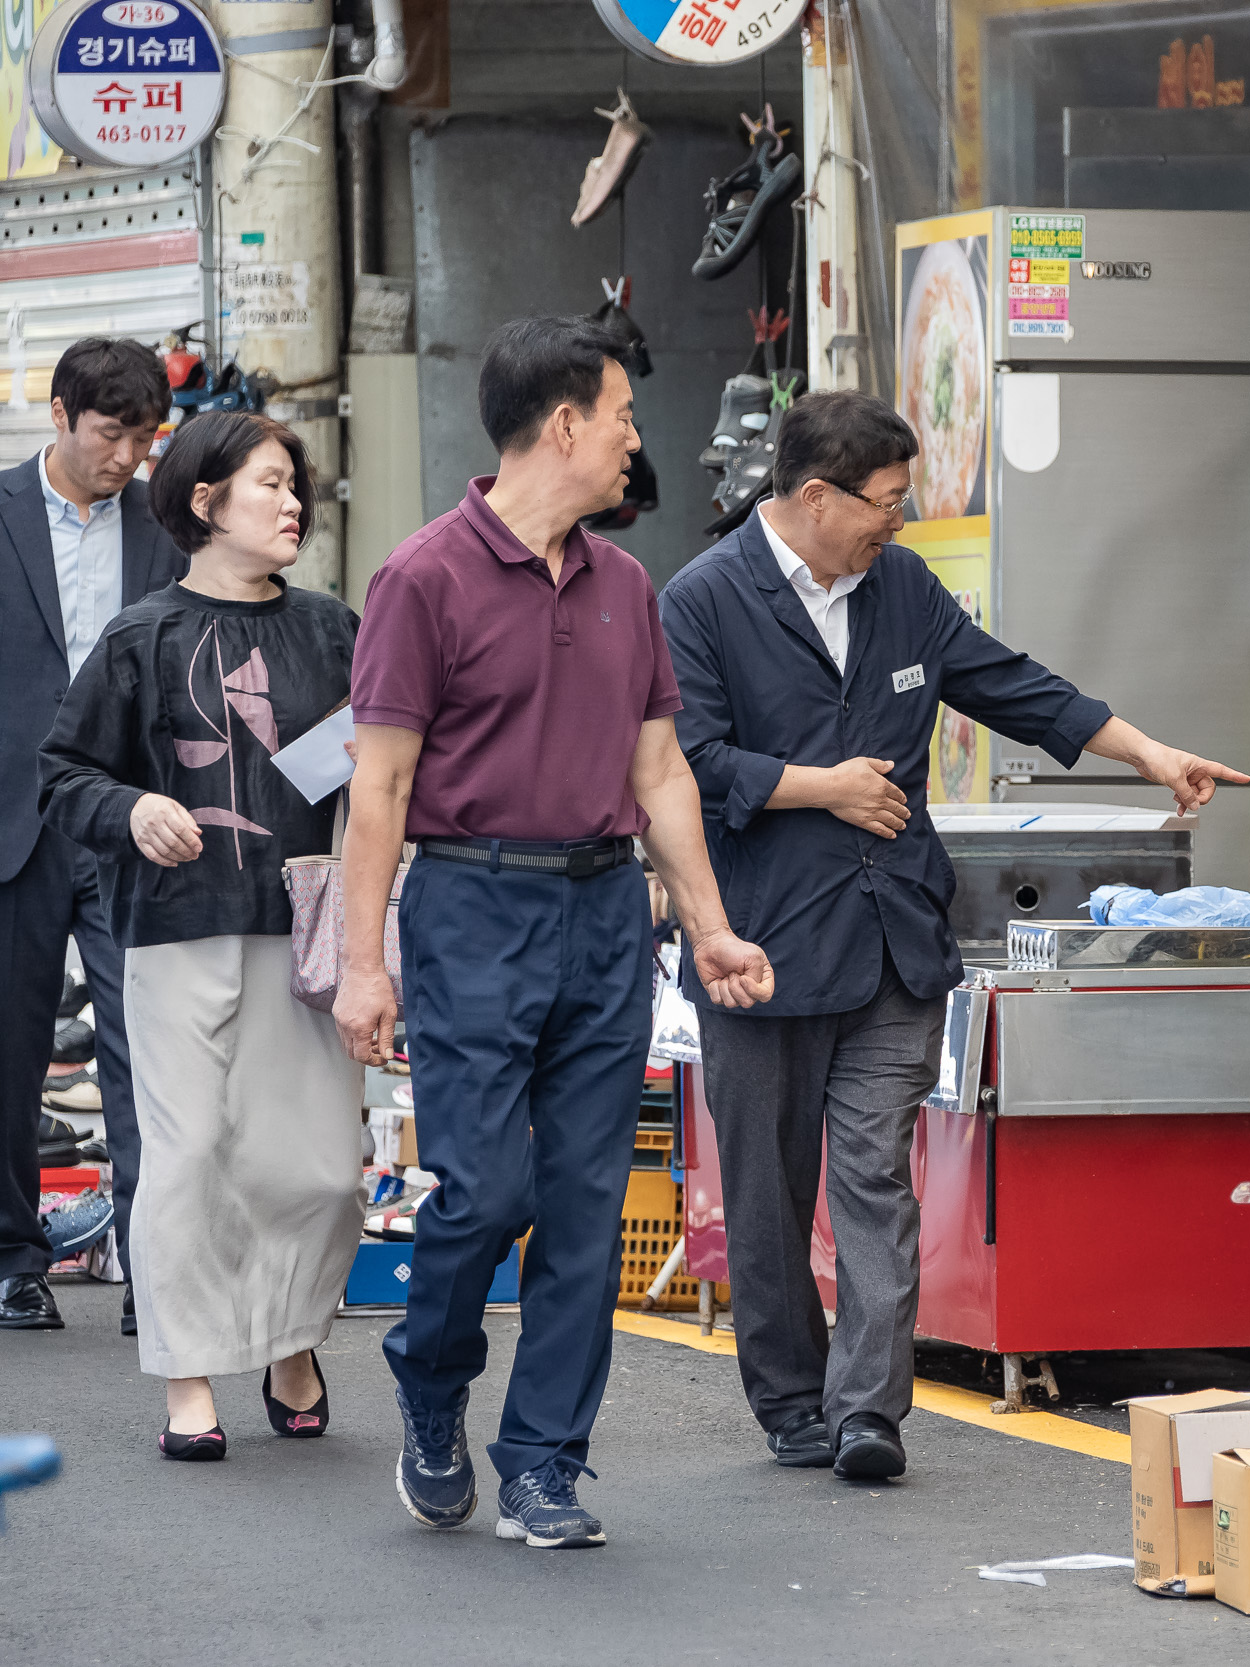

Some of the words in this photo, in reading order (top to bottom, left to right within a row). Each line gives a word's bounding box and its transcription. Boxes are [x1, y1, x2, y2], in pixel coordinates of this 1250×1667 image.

[118, 4, 166, 22] 가-36
[736, 0, 790, 47] 497-
[77, 36, 196, 66] 경기슈퍼
[92, 80, 182, 114] 슈퍼
[97, 124, 187, 143] 463-0127
[1080, 261, 1151, 281] WOOSUNG
